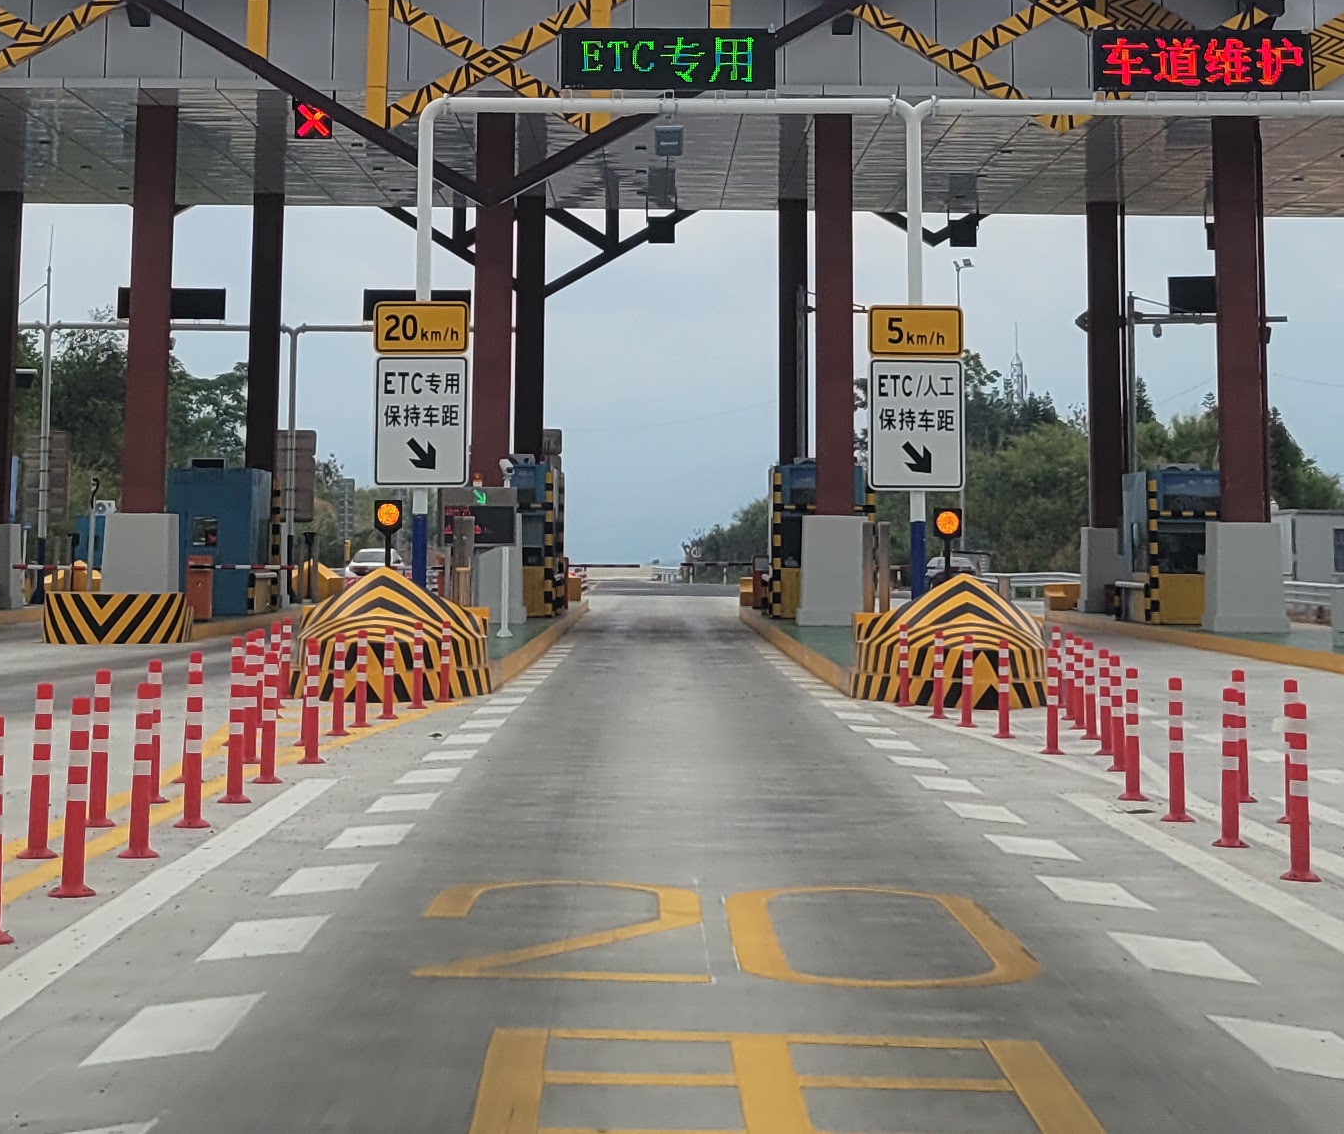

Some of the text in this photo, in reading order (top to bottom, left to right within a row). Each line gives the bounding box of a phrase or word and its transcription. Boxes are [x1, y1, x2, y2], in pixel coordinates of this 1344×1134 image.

[580, 36, 755, 83] ETC专用
[1102, 37, 1304, 86] 车道维护
[384, 314, 459, 342] 20km/h
[887, 317, 945, 345] 5km/h
[383, 372, 460, 395] ETC专用
[878, 374, 955, 398] ETC/人工
[384, 404, 460, 427] 保持车距
[878, 408, 955, 432] 保持车距
[411, 879, 1042, 988] 20
